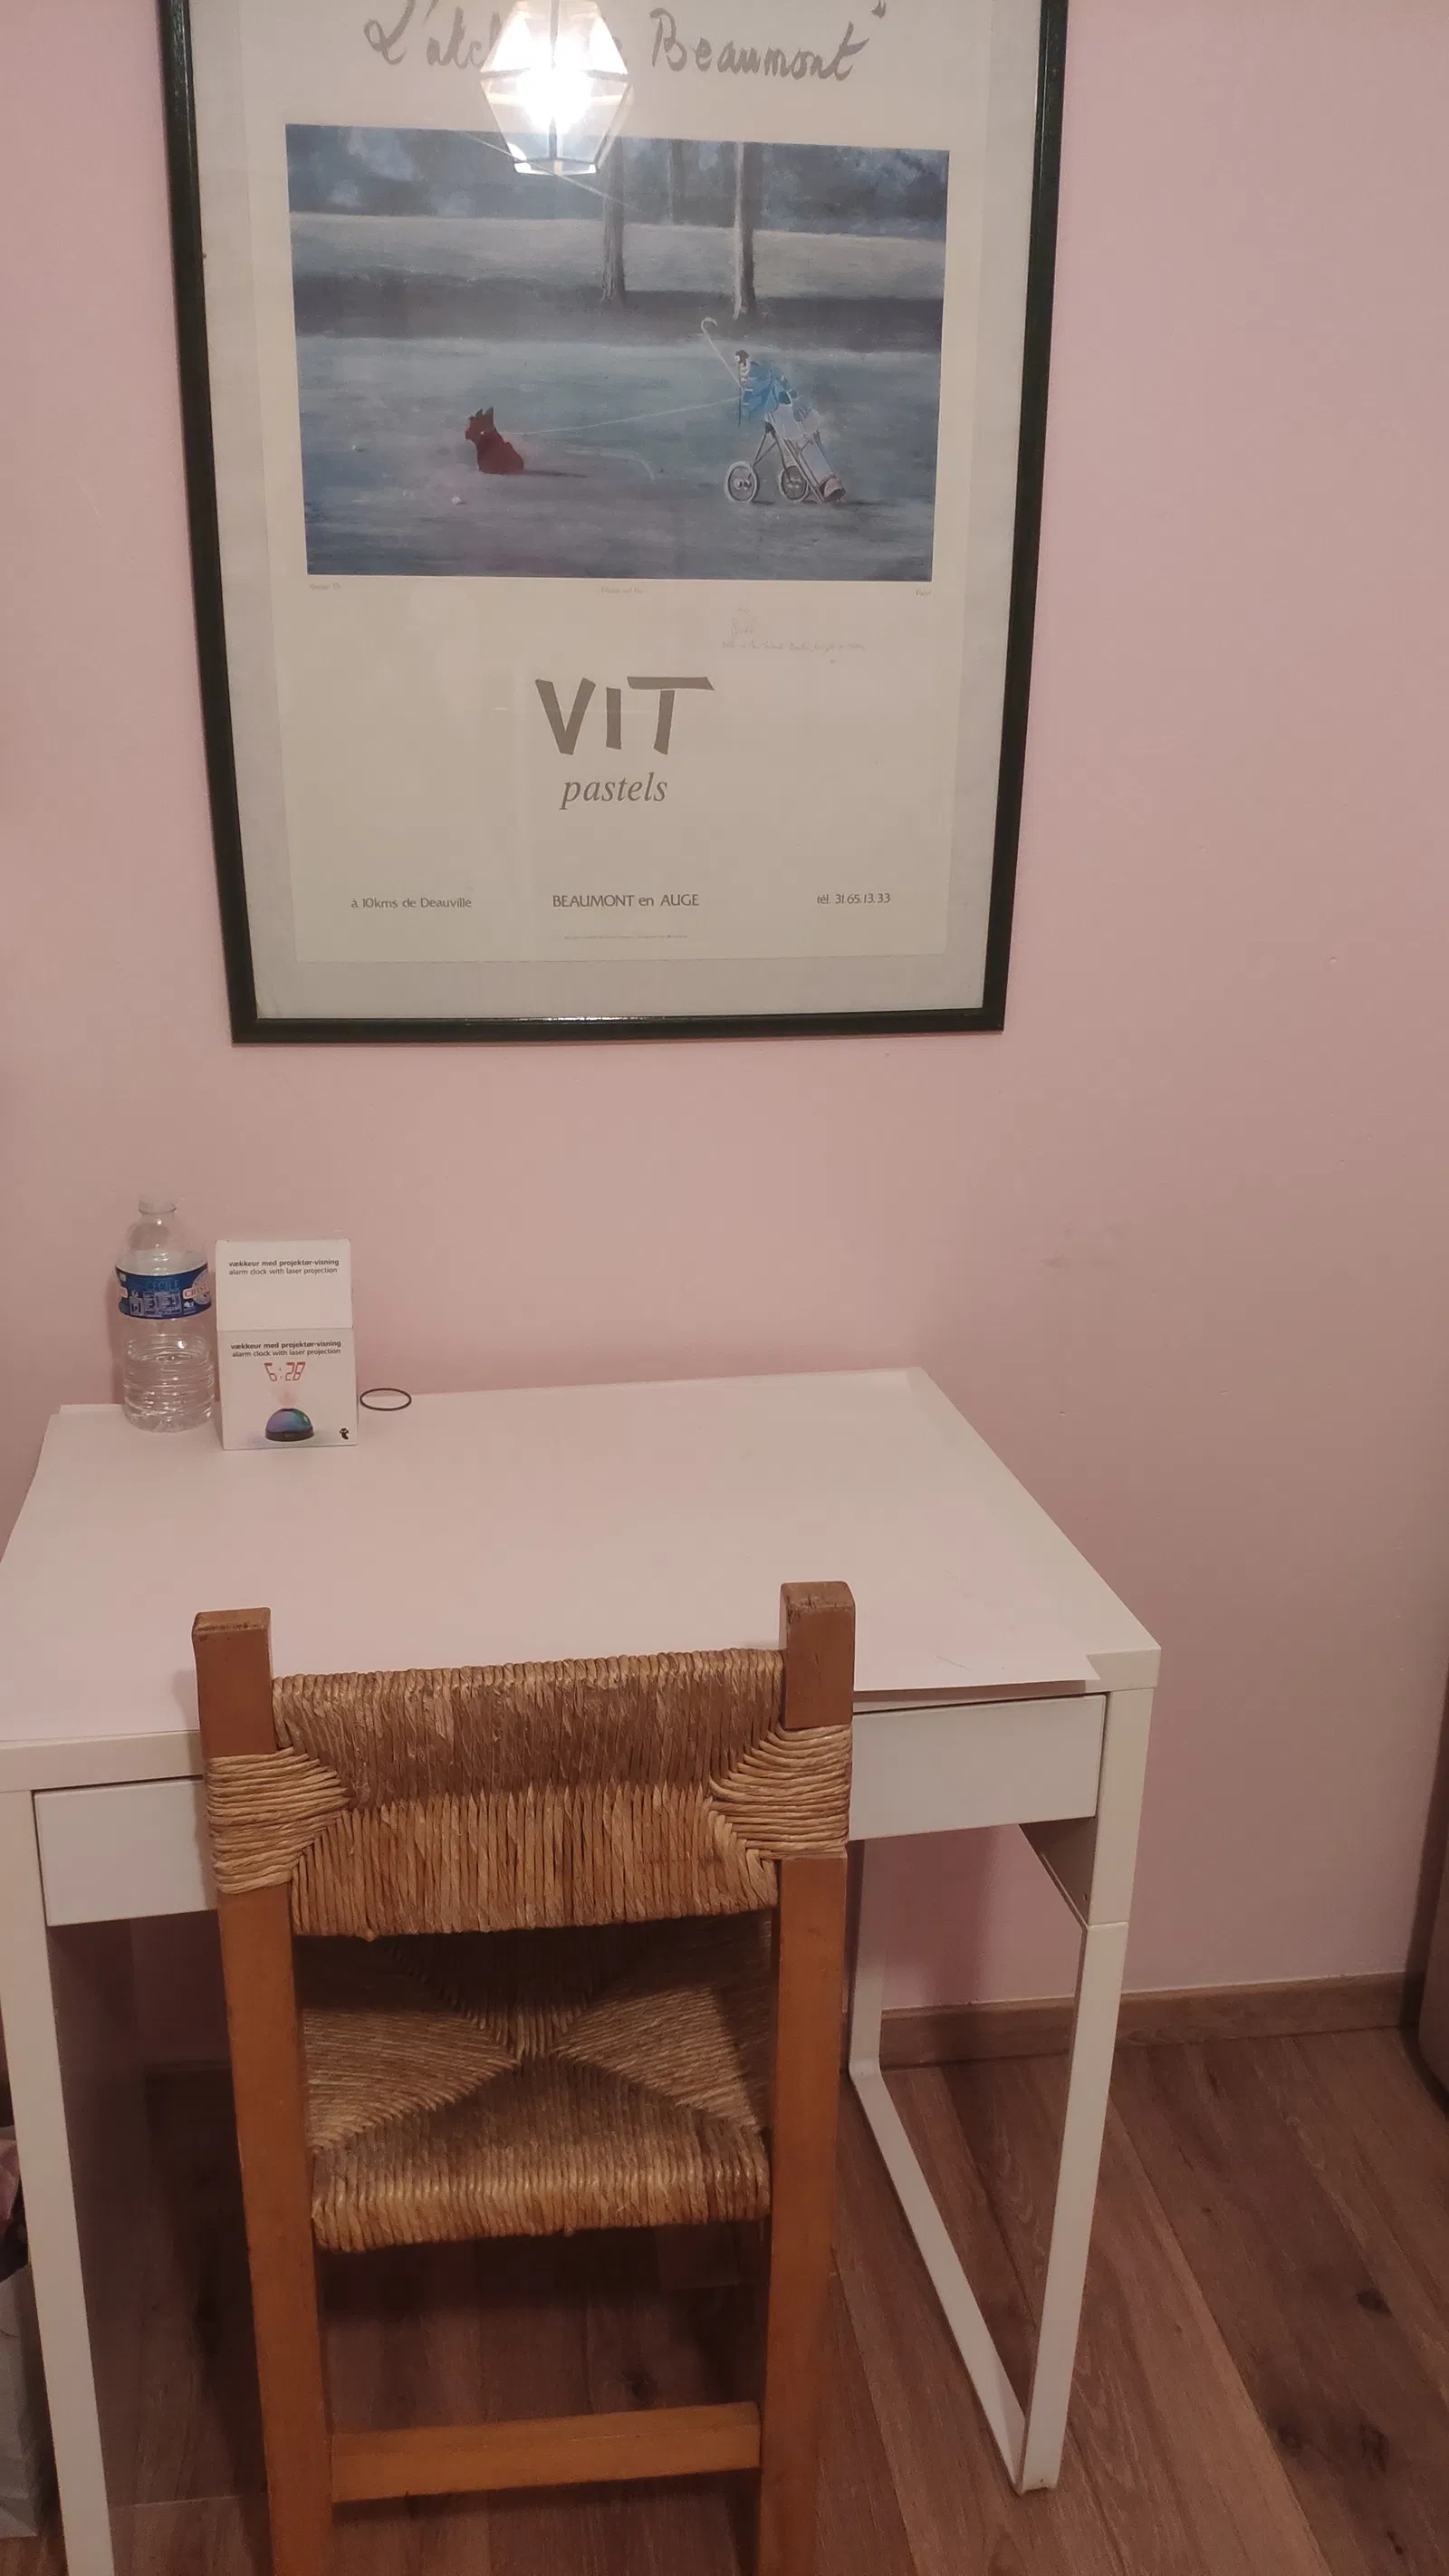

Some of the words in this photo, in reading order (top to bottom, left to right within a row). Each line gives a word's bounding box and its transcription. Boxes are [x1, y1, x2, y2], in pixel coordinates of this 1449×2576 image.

[534, 676, 715, 756] VIT
[559, 772, 668, 812] pastels
[362, 898, 398, 909] 10kms
[402, 898, 417, 909] de
[419, 897, 473, 909] Deauville
[552, 894, 635, 908] BEAUMONT
[638, 897, 655, 907] en
[660, 894, 700, 908] AUGE
[228, 1267, 248, 1276] alarm
[250, 1267, 267, 1275] clock
[269, 1267, 284, 1275] with
[303, 1266, 338, 1275] projection
[253, 1350, 271, 1358] clock
[306, 1348, 341, 1357] projection
